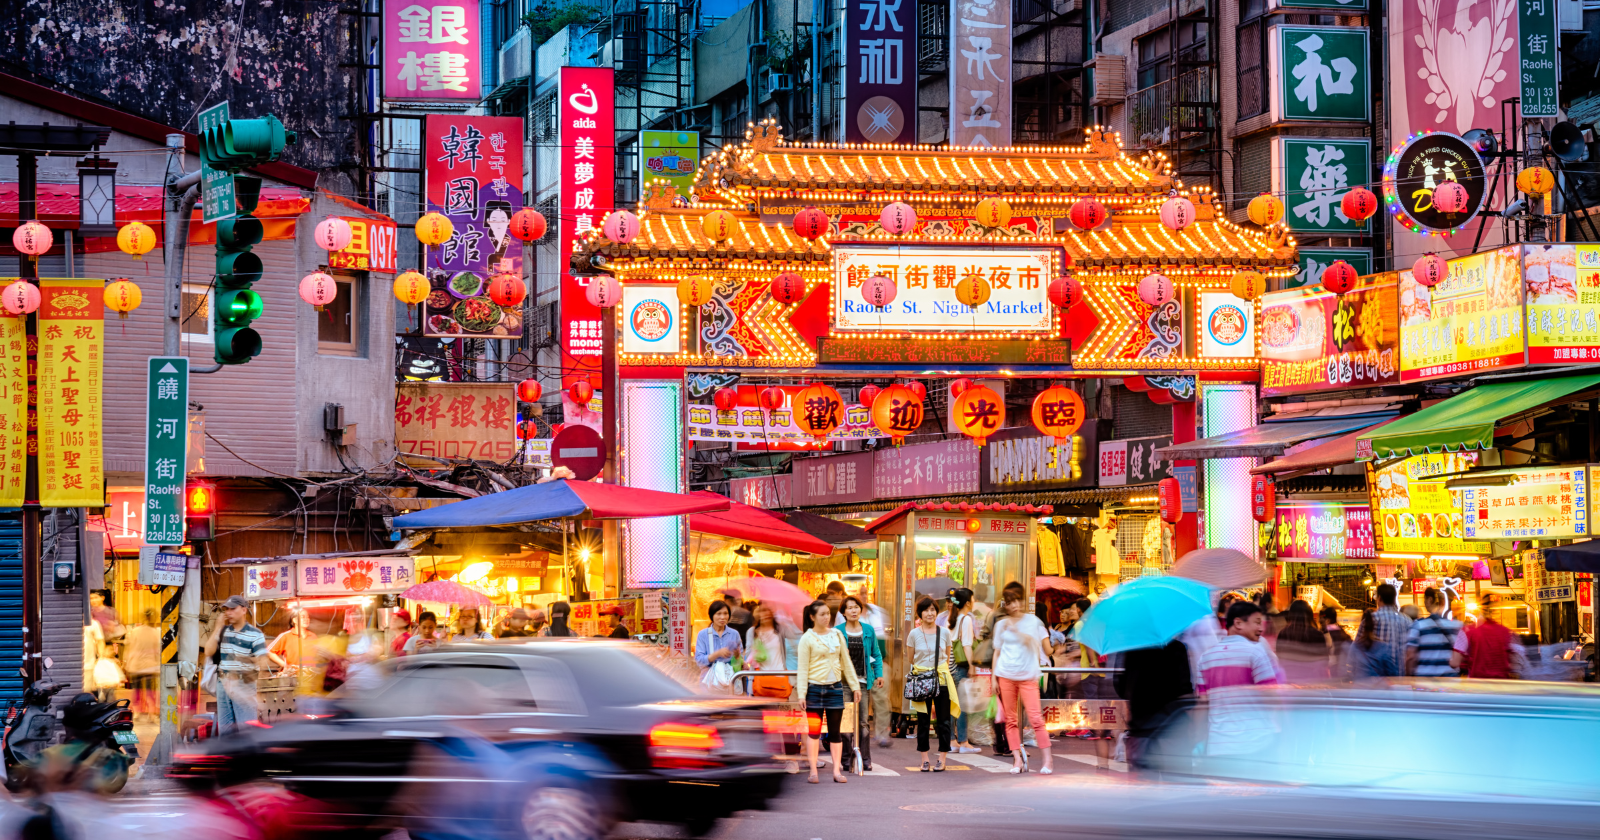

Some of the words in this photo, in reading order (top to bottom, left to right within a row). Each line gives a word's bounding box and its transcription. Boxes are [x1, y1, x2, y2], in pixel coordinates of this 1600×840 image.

[397, 4, 470, 92] 銀樓
[859, 0, 904, 85] 永和
[1523, 59, 1553, 69] RaoHe
[1523, 73, 1536, 83] St.
[1525, 88, 1535, 97] 30
[1543, 88, 1553, 97] 33
[1524, 105, 1538, 113] 226
[1542, 105, 1556, 113] 255
[573, 117, 596, 129] aida
[489, 132, 509, 196] 한국관
[438, 124, 484, 265] 韓國館
[330, 256, 368, 268] 1+2樓
[902, 300, 922, 314] St.
[986, 300, 1044, 314] Market
[45, 324, 96, 340] 恭祝
[1454, 326, 1464, 345] VS
[804, 396, 840, 430] 歡
[889, 399, 920, 432] 迎
[964, 399, 1000, 429] 光
[1042, 400, 1076, 427] 臨
[155, 377, 179, 480] 饒河街
[990, 434, 1073, 484] HAMMER
[1100, 450, 1126, 477] 各國名藥
[904, 453, 946, 485] 三禾百貨
[808, 464, 826, 496] 永和
[149, 484, 182, 495] RaoHe
[148, 498, 162, 509] St.
[1574, 470, 1586, 534] 實在老口味
[150, 514, 160, 524] 30
[169, 514, 180, 524] 33
[990, 520, 1028, 533] 服務台
[148, 532, 163, 541] 226
[166, 532, 182, 541] 255
[380, 566, 409, 583] 蟹肉
[674, 628, 684, 656] 禁止進入
